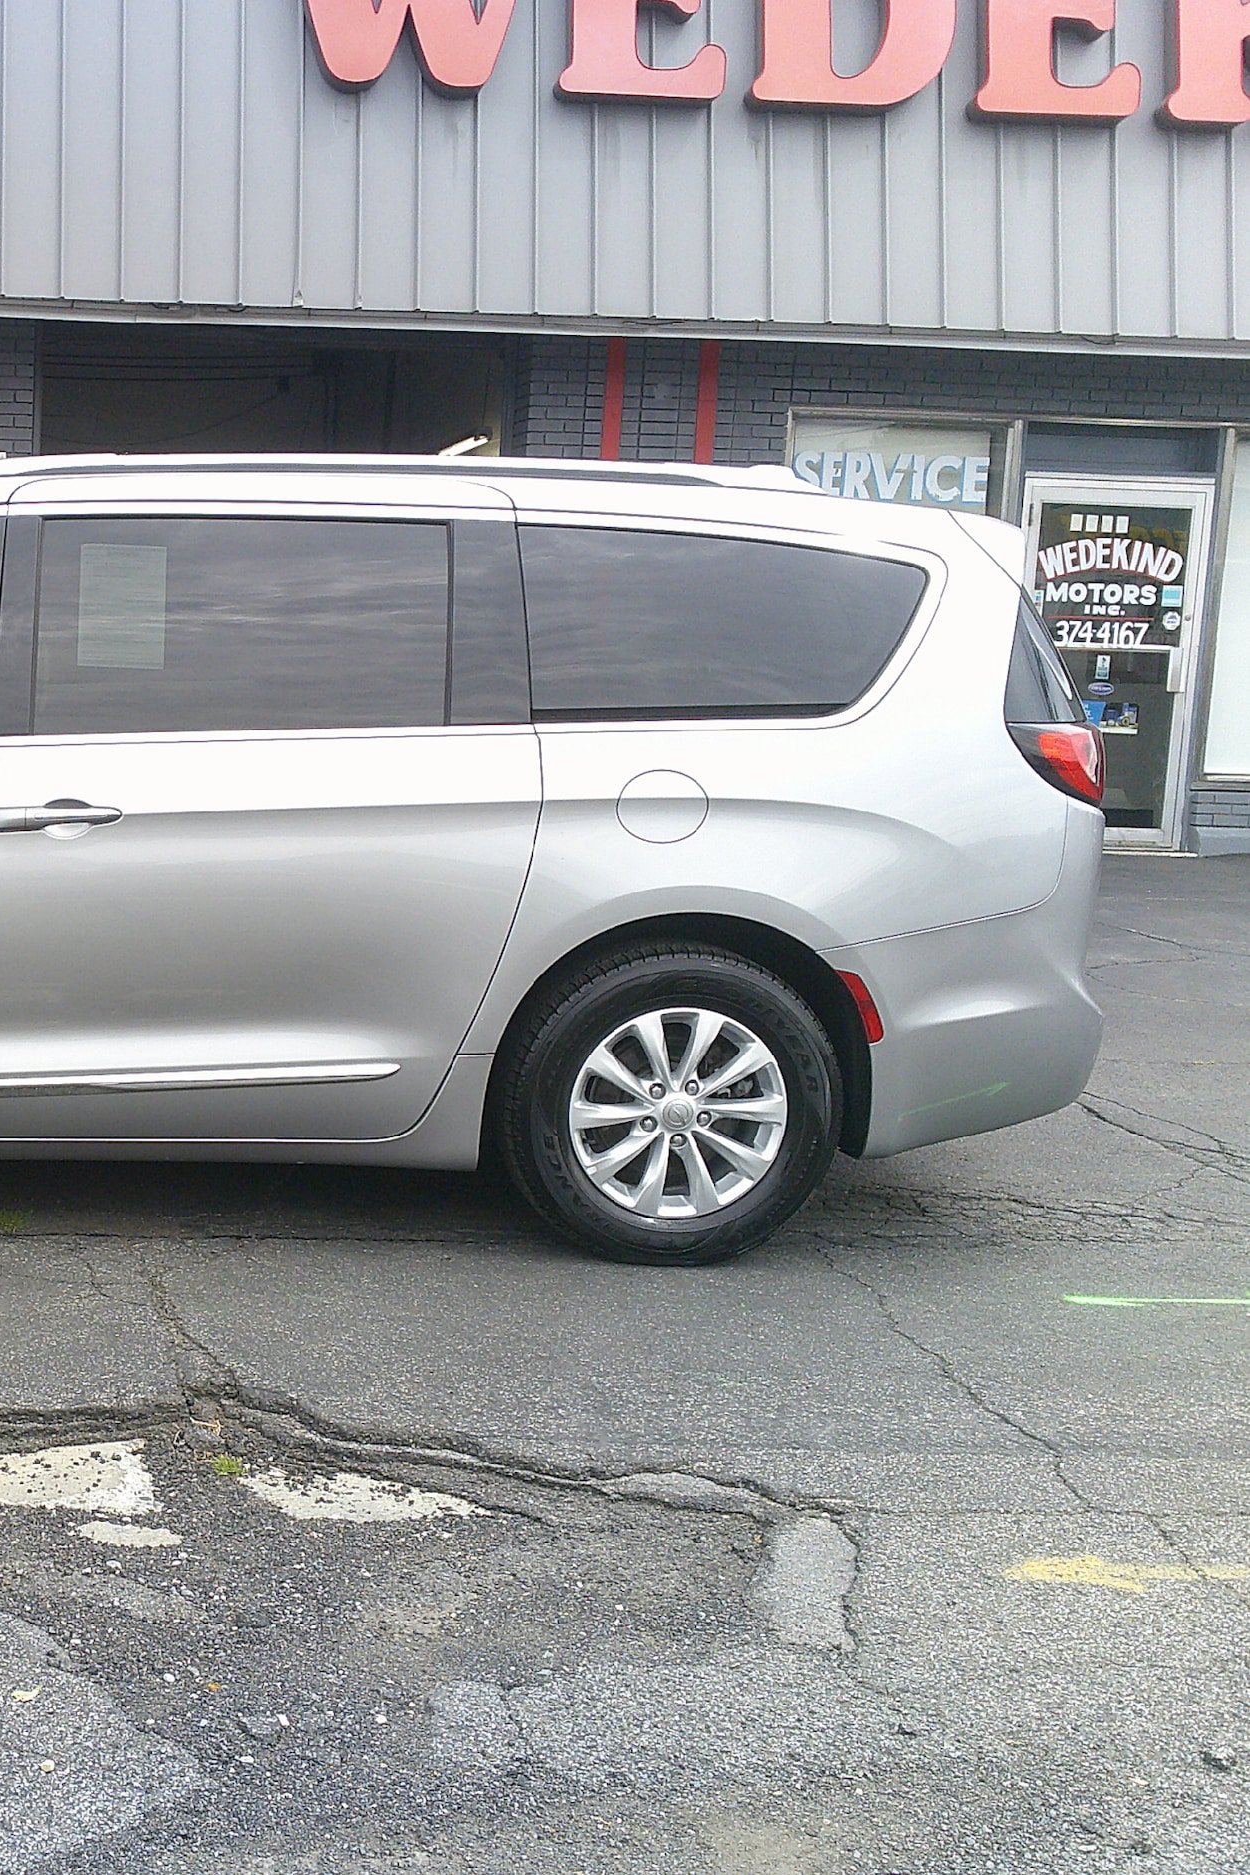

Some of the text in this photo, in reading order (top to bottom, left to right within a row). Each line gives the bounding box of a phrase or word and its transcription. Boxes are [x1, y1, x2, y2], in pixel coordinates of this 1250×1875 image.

[794, 451, 991, 503] SERVICE
[1038, 537, 1184, 583] WEDEKIND
[1046, 581, 1158, 606] MOTORS
[1083, 604, 1126, 616] INC.
[1054, 620, 1150, 649] 374-4167
